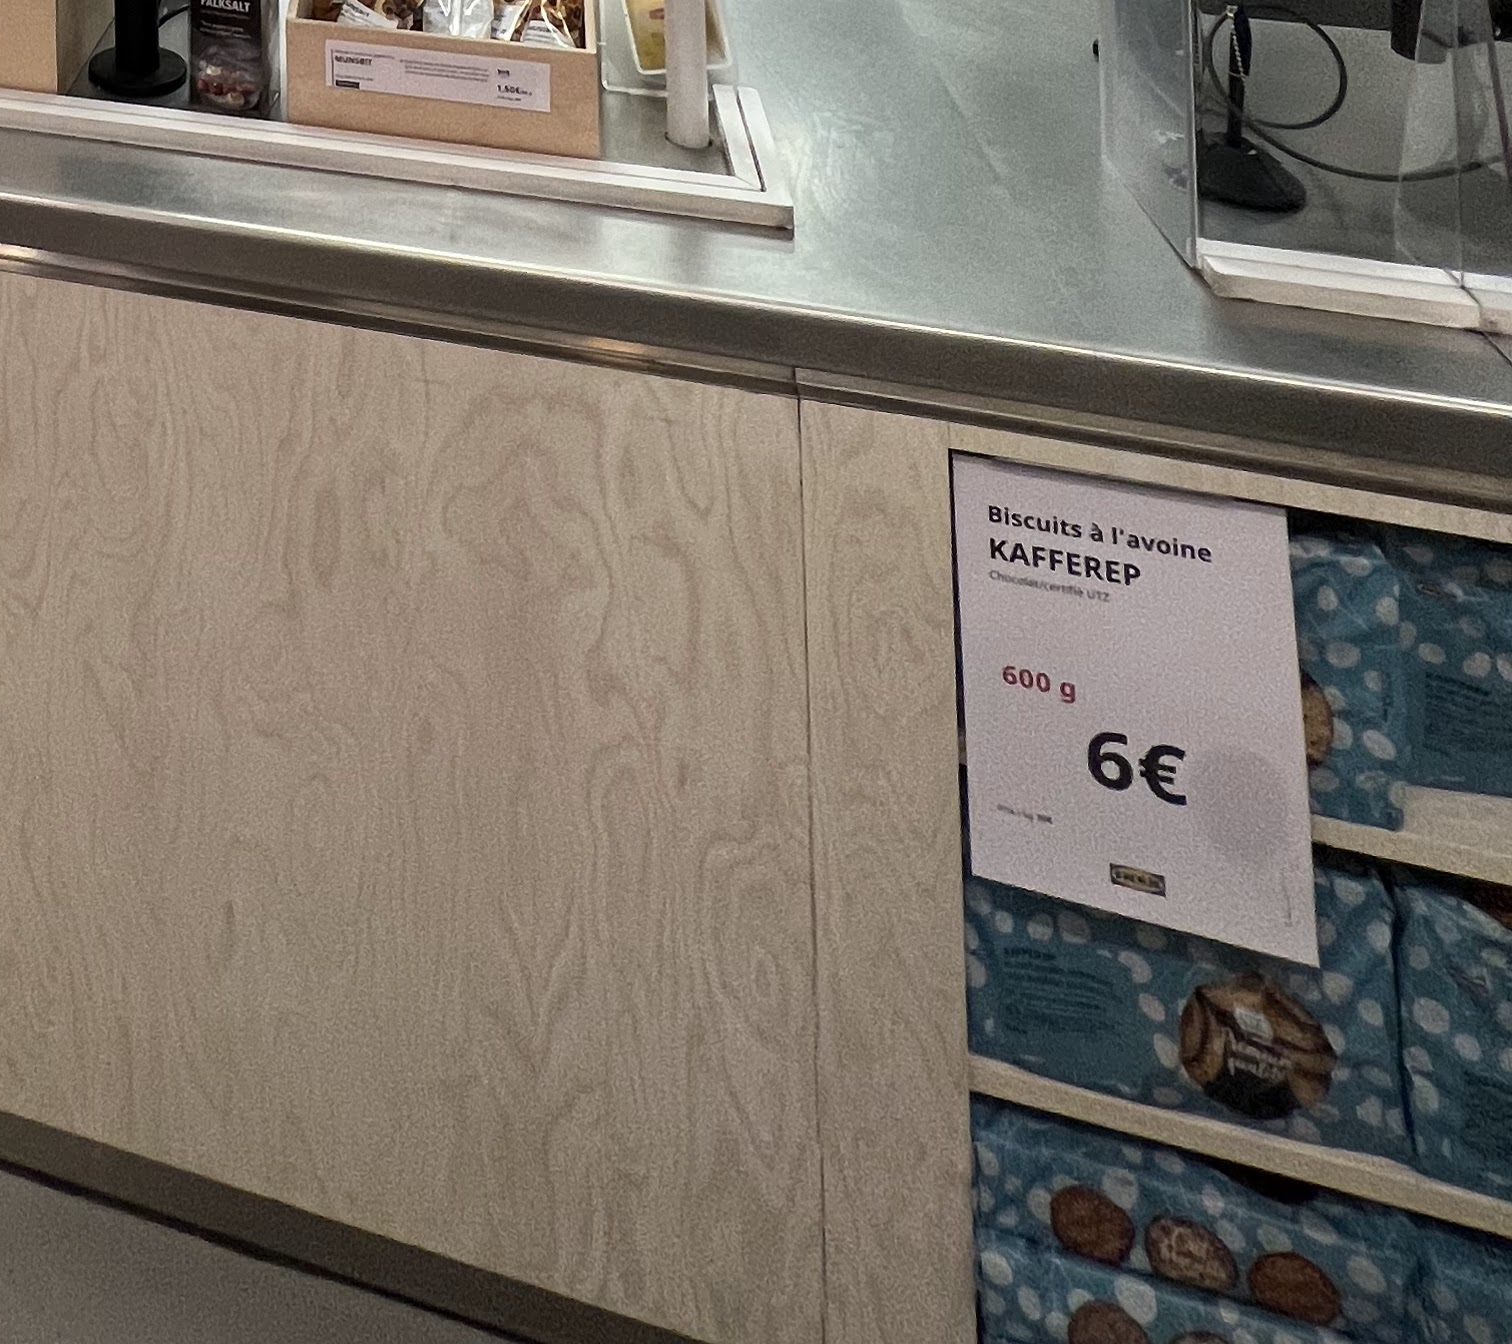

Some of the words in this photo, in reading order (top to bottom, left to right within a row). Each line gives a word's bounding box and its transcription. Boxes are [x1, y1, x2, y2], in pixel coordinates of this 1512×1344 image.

[988, 504, 1083, 538] Biscuits
[1089, 522, 1104, 543] à
[1111, 526, 1212, 563] l'avoine
[989, 537, 1142, 587] KAFFEREP
[1002, 665, 1051, 693] 600
[1060, 681, 1076, 704] g
[1088, 731, 1188, 806] 6€
